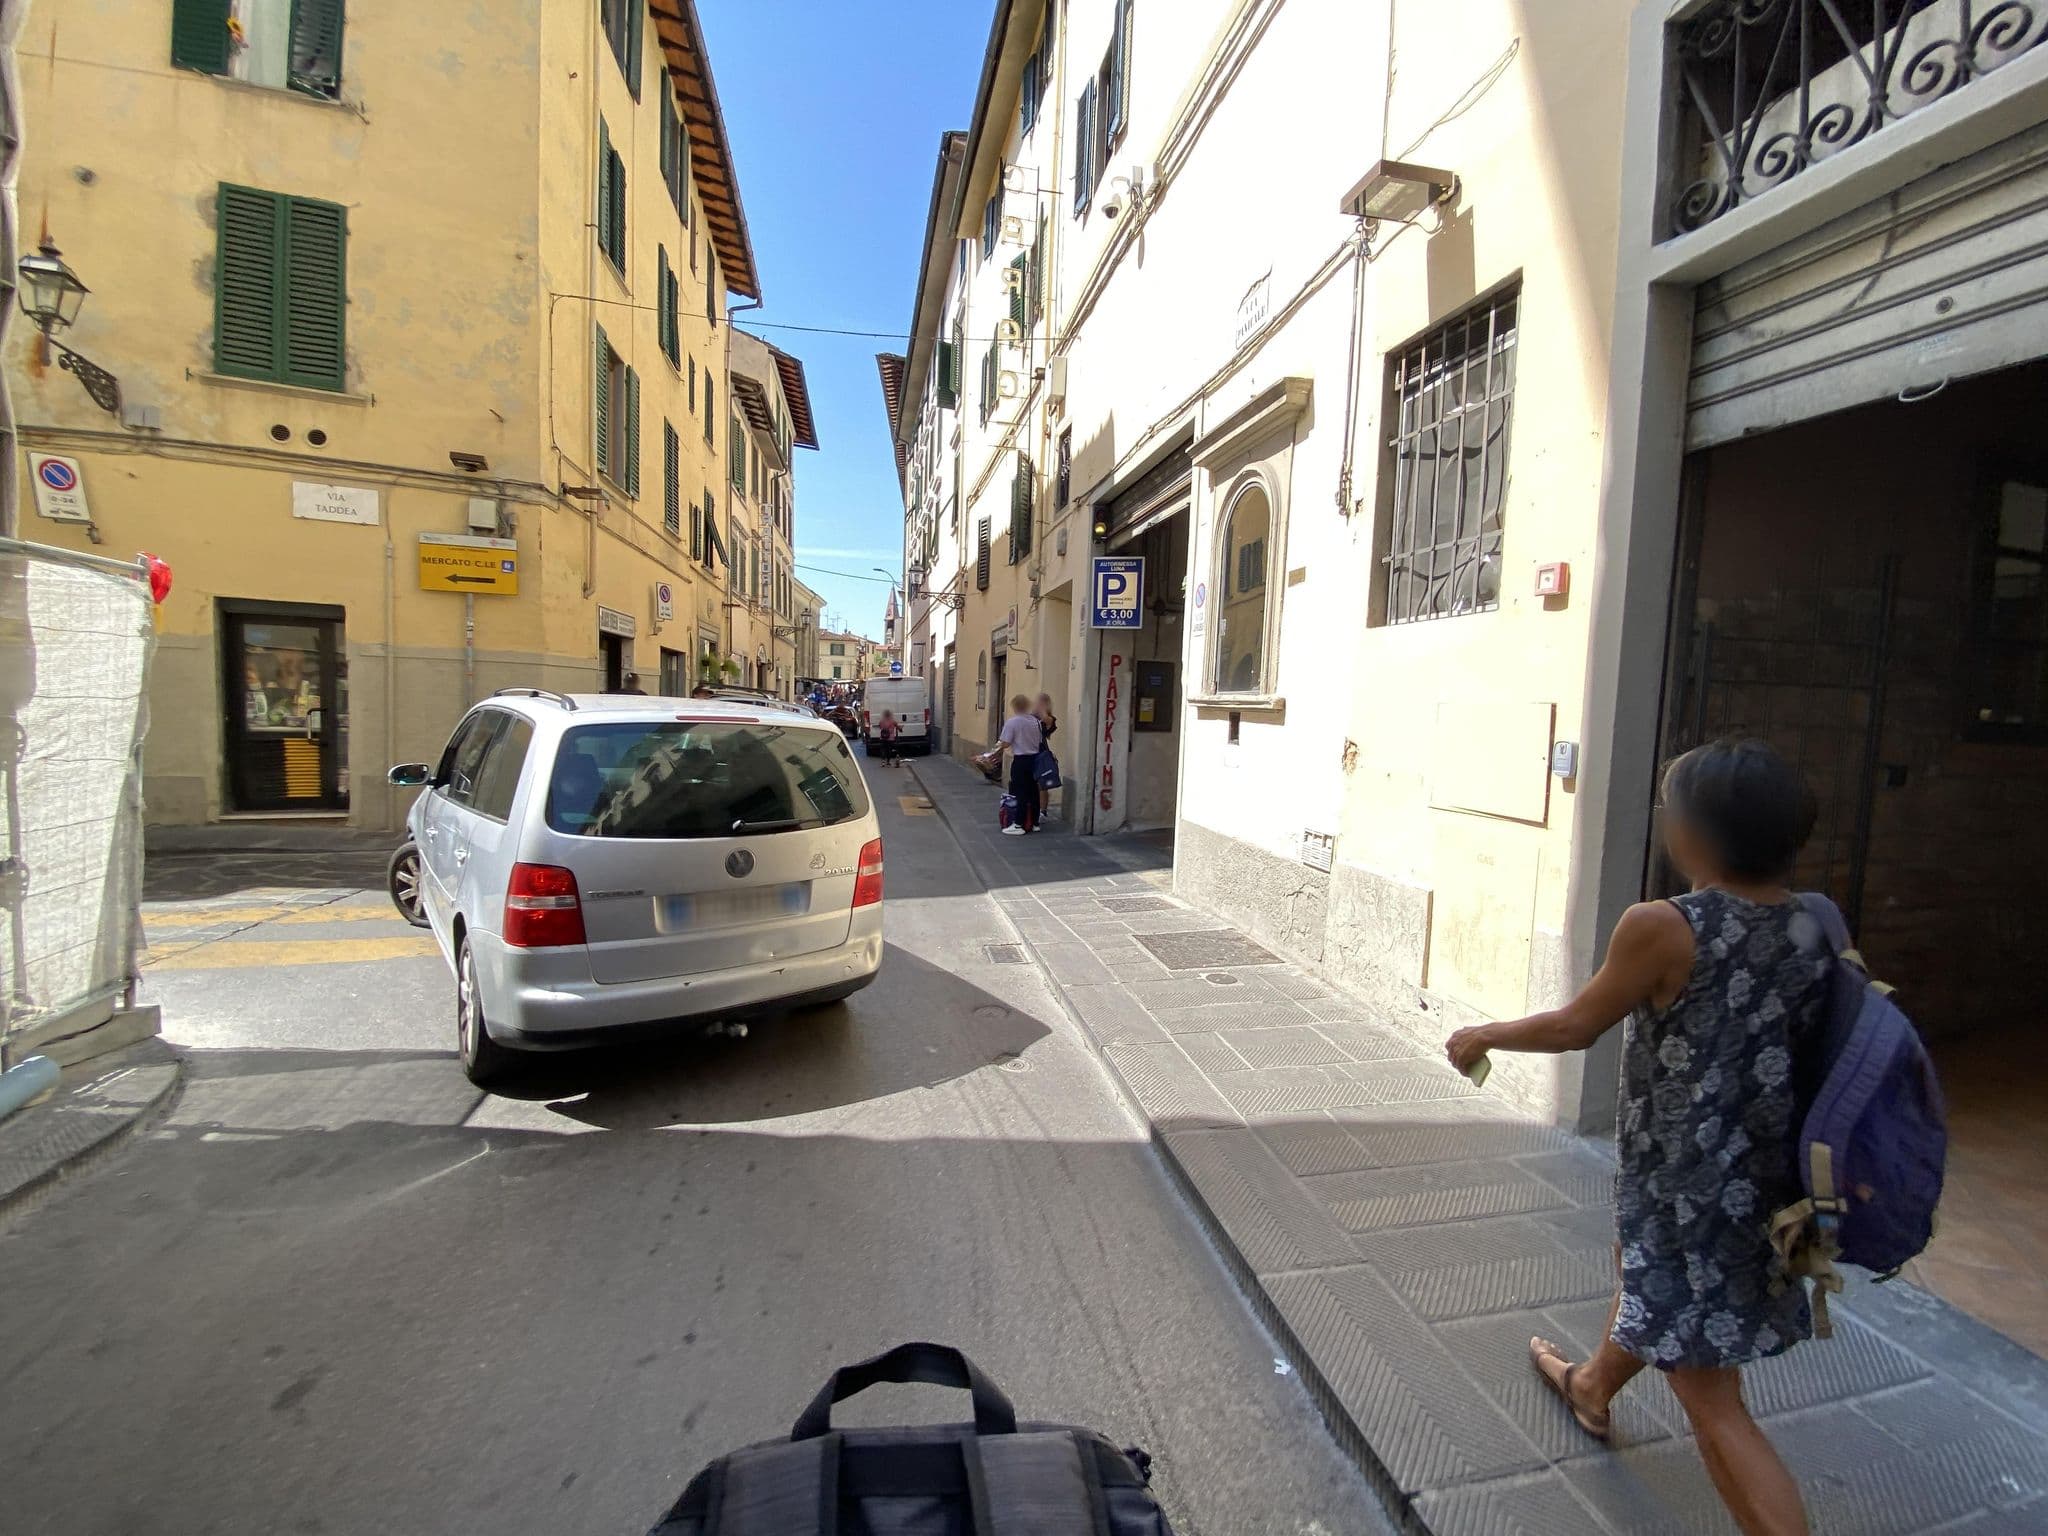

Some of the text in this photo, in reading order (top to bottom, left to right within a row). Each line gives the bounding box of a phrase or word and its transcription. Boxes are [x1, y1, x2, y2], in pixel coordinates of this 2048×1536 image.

[327, 492, 346, 502] VIA
[315, 504, 358, 516] TADDEA
[422, 556, 471, 567] MERCATO
[474, 560, 496, 569] C.LE
[1102, 574, 1127, 608] P
[1110, 609, 1134, 619] 3,00
[1100, 654, 1122, 812] PARKING
